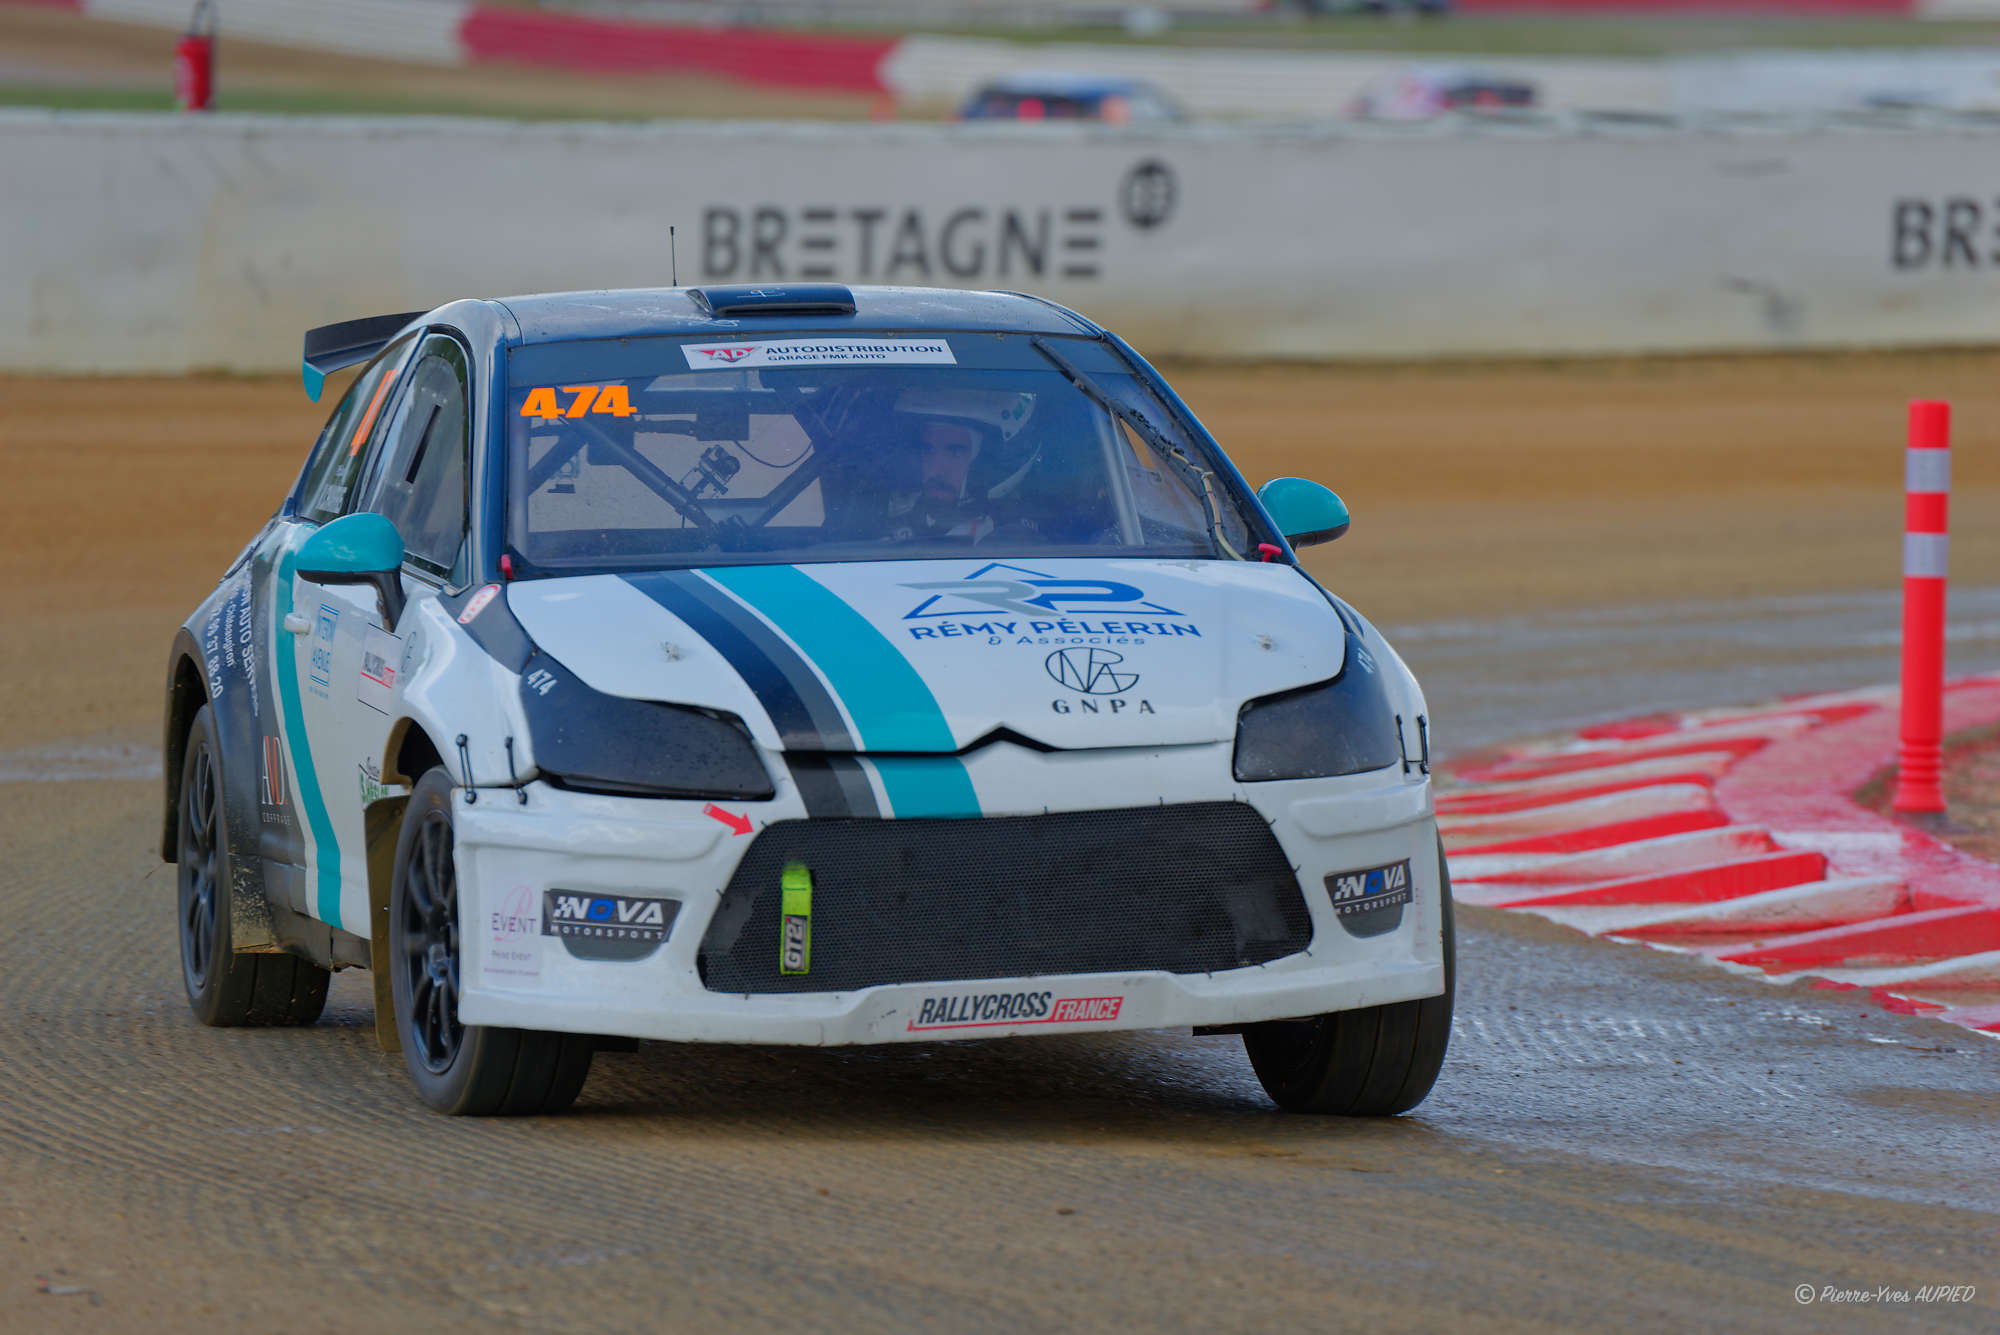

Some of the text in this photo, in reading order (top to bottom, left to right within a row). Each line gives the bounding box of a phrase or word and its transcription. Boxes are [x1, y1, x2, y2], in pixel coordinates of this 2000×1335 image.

[702, 206, 1105, 277] BRETAGNE
[1892, 198, 2000, 267] BR
[766, 344, 943, 355] AUTODISTRIBUTION
[520, 385, 637, 419] 474
[908, 621, 1017, 640] RÉMY
[1016, 635, 1145, 645] Associés
[210, 676, 224, 699] 20
[528, 669, 557, 696] 474
[1051, 699, 1156, 714] GNPA
[492, 913, 536, 934] EVENT
[551, 925, 664, 940] MOTORSPORT
[917, 991, 1052, 1024] RALLYCROSS
[1054, 999, 1121, 1021] FRANCE
